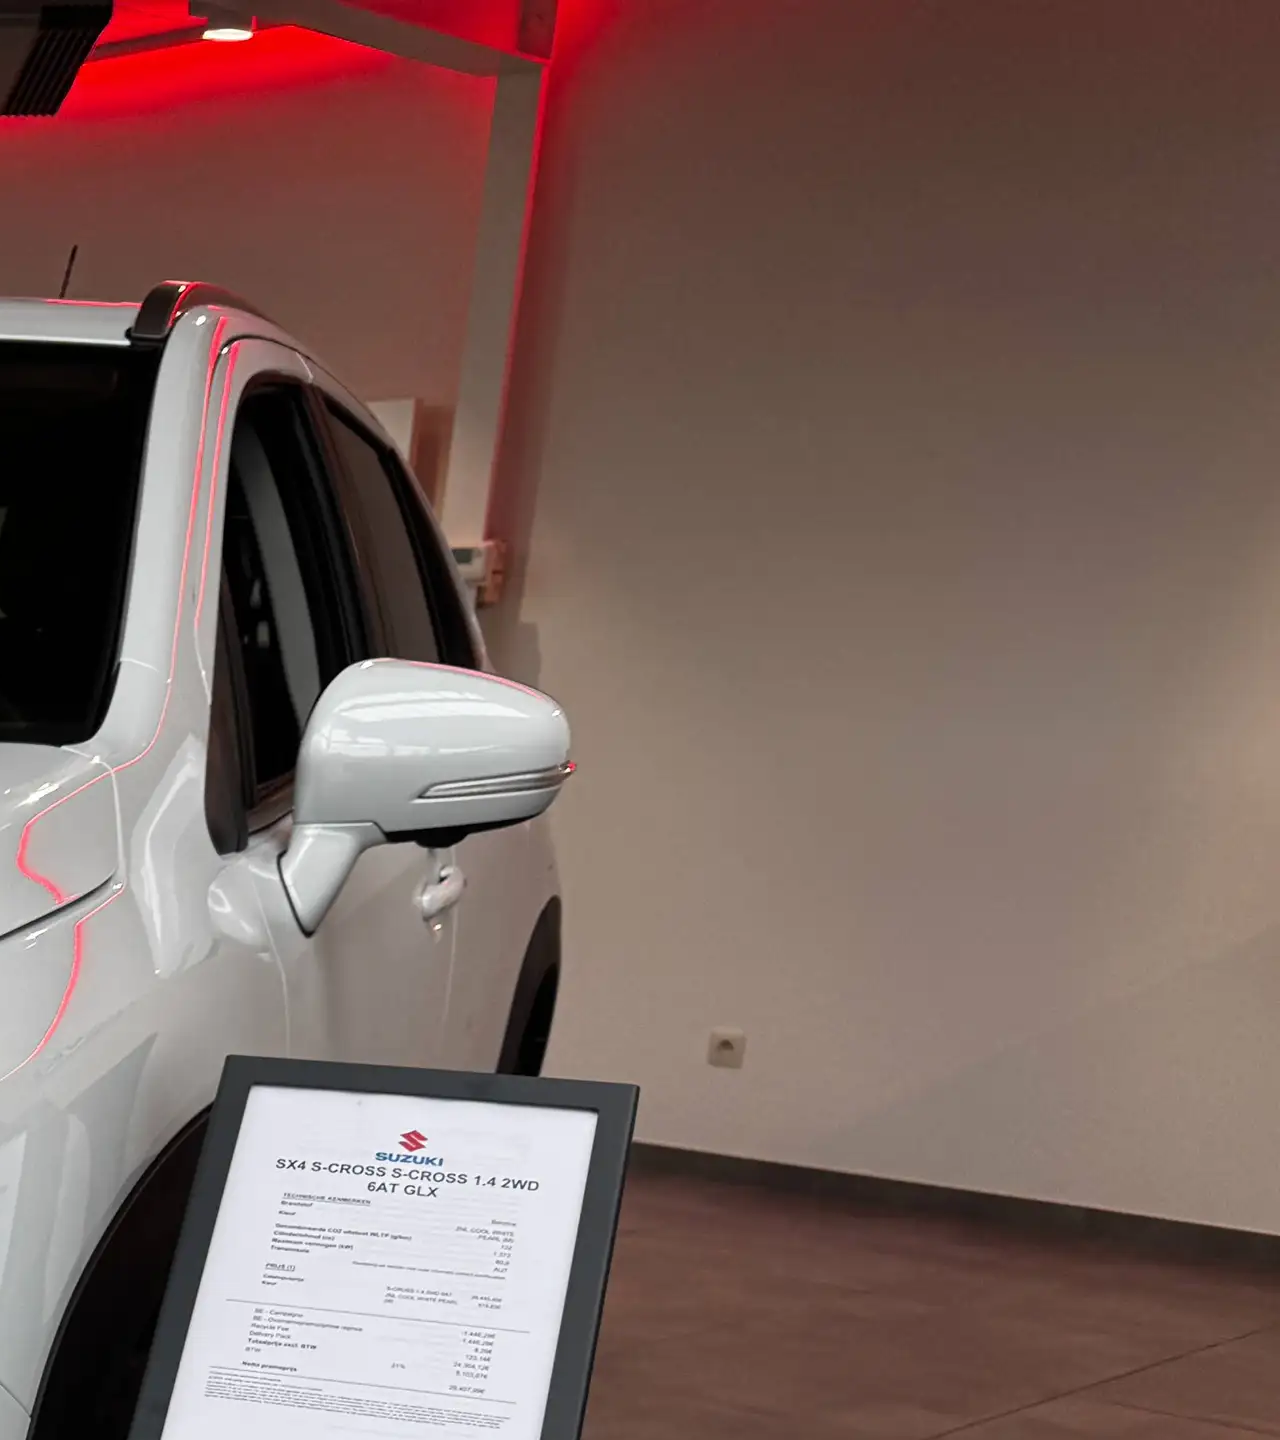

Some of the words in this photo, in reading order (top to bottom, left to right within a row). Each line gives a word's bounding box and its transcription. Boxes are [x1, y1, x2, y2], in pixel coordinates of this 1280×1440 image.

[375, 1151, 443, 1167] SUZUKI
[275, 1158, 306, 1171] SX4
[311, 1161, 386, 1178] S-CROSS
[391, 1167, 468, 1184] S-CROSS
[473, 1174, 496, 1187] 1.4
[501, 1178, 540, 1191] 2WD
[367, 1181, 399, 1194] 6AT
[403, 1184, 439, 1198] GLX
[249, 1330, 274, 1339] Delivery
